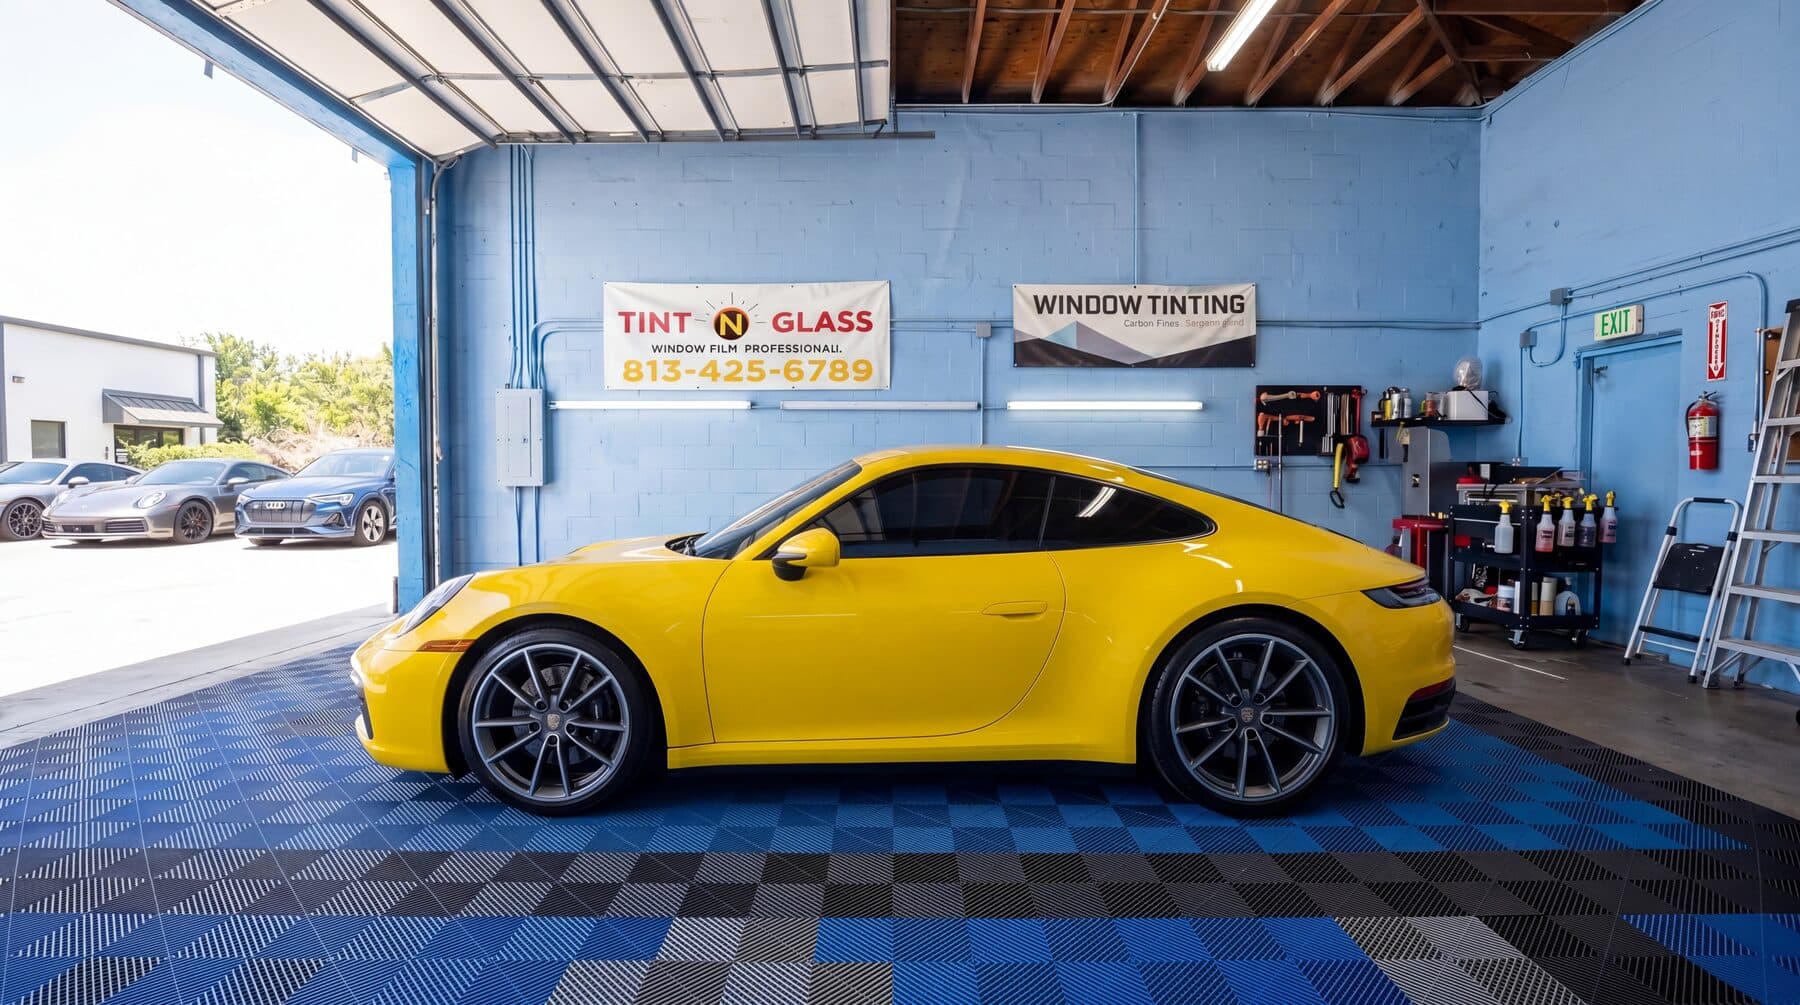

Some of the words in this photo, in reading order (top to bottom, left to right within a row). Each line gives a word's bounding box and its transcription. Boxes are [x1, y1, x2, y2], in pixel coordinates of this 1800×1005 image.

[1033, 294, 1142, 315] WINDOW
[1147, 294, 1245, 315] TINTING
[617, 311, 692, 334] TINT
[719, 312, 743, 337] N
[771, 310, 874, 333] GLASS
[1123, 319, 1154, 328] Carbon
[1601, 309, 1631, 337] EXIT
[651, 344, 706, 353] WINDOW
[709, 344, 738, 353] FILM
[622, 359, 874, 383] 813-425-6789
